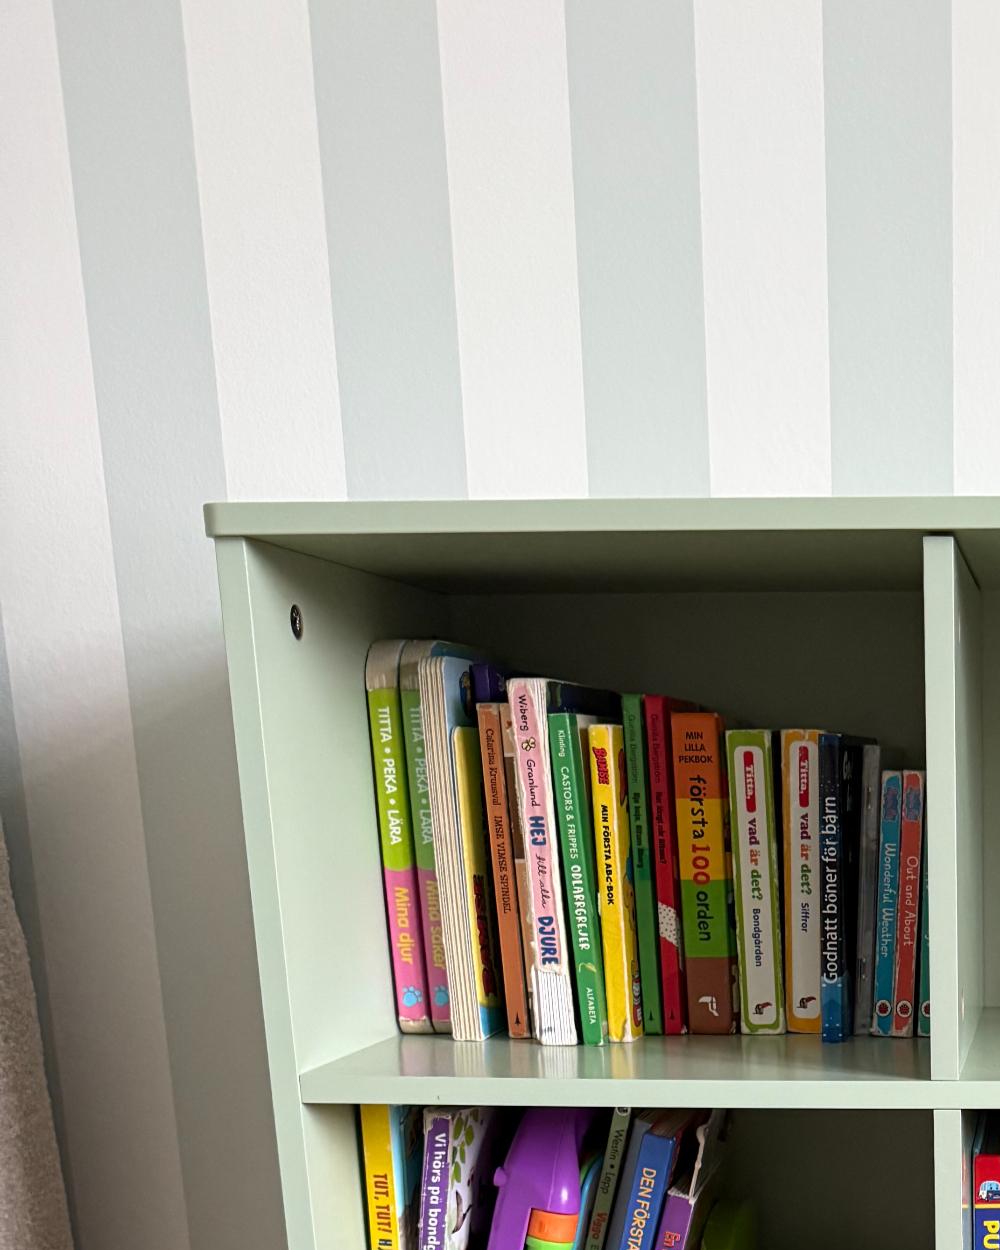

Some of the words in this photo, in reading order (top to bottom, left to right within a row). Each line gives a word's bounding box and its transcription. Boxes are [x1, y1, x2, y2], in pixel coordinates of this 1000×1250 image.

[377, 706, 391, 743] TITTA
[409, 705, 424, 742] TITTA
[685, 731, 704, 741] MIN
[485, 728, 499, 765] Catarina
[518, 694, 531, 731] Wiberg
[526, 759, 540, 807] Granlund
[557, 730, 567, 757] Klinting
[678, 755, 713, 764] PEKBOK
[684, 743, 707, 752] LILLA
[378, 758, 397, 794] PEKA
[414, 757, 429, 794] PEKA
[592, 747, 610, 785] BAMSE
[745, 764, 755, 799] Titta,
[800, 760, 809, 794] Titta,
[489, 767, 501, 806] Kruusval
[560, 766, 573, 811] CASTORS
[566, 814, 575, 822] &
[600, 804, 609, 822] MIN
[689, 775, 709, 839] första
[822, 796, 838, 835] barn
[386, 809, 403, 845] LÄRA
[494, 815, 505, 840] IMSE
[529, 816, 547, 846] HEJ
[567, 824, 578, 859] FRIPPES
[748, 817, 760, 845] vad
[800, 813, 811, 840] vad
[497, 842, 509, 873] VIMSE
[602, 825, 612, 861] FÖRSTA
[750, 849, 761, 866] är
[800, 844, 811, 860] är
[822, 838, 837, 863] för
[536, 853, 549, 877] till
[691, 843, 711, 885] 100
[801, 864, 812, 896] det?
[882, 843, 897, 903] Wonderful
[906, 856, 919, 880] Out
[425, 880, 440, 921] Mina
[499, 874, 511, 914] SPINDEL
[539, 880, 551, 909] alla
[751, 869, 763, 900] det?
[823, 866, 838, 914] böner
[905, 884, 915, 905] and
[394, 887, 410, 928] Mina
[570, 864, 590, 950] ODLARRGREJER
[696, 890, 714, 942] orden
[801, 903, 810, 933] Siffror
[751, 908, 764, 967] Bondgården
[880, 908, 894, 959] Weather
[903, 910, 916, 946] About
[396, 932, 415, 965] djur
[823, 918, 838, 984] Godnatt
[586, 987, 597, 1024] ALFABETA
[434, 1133, 447, 1147] Vi
[609, 1129, 625, 1161] Westin
[431, 1151, 446, 1183] hörs
[600, 1172, 614, 1194] Lepp
[638, 1167, 657, 1197] DEN
[373, 1173, 389, 1200] TUT,
[427, 1186, 443, 1205] på
[375, 1205, 392, 1234] TUT!
[591, 1212, 608, 1240] Viggo
[662, 1231, 681, 1246] En
